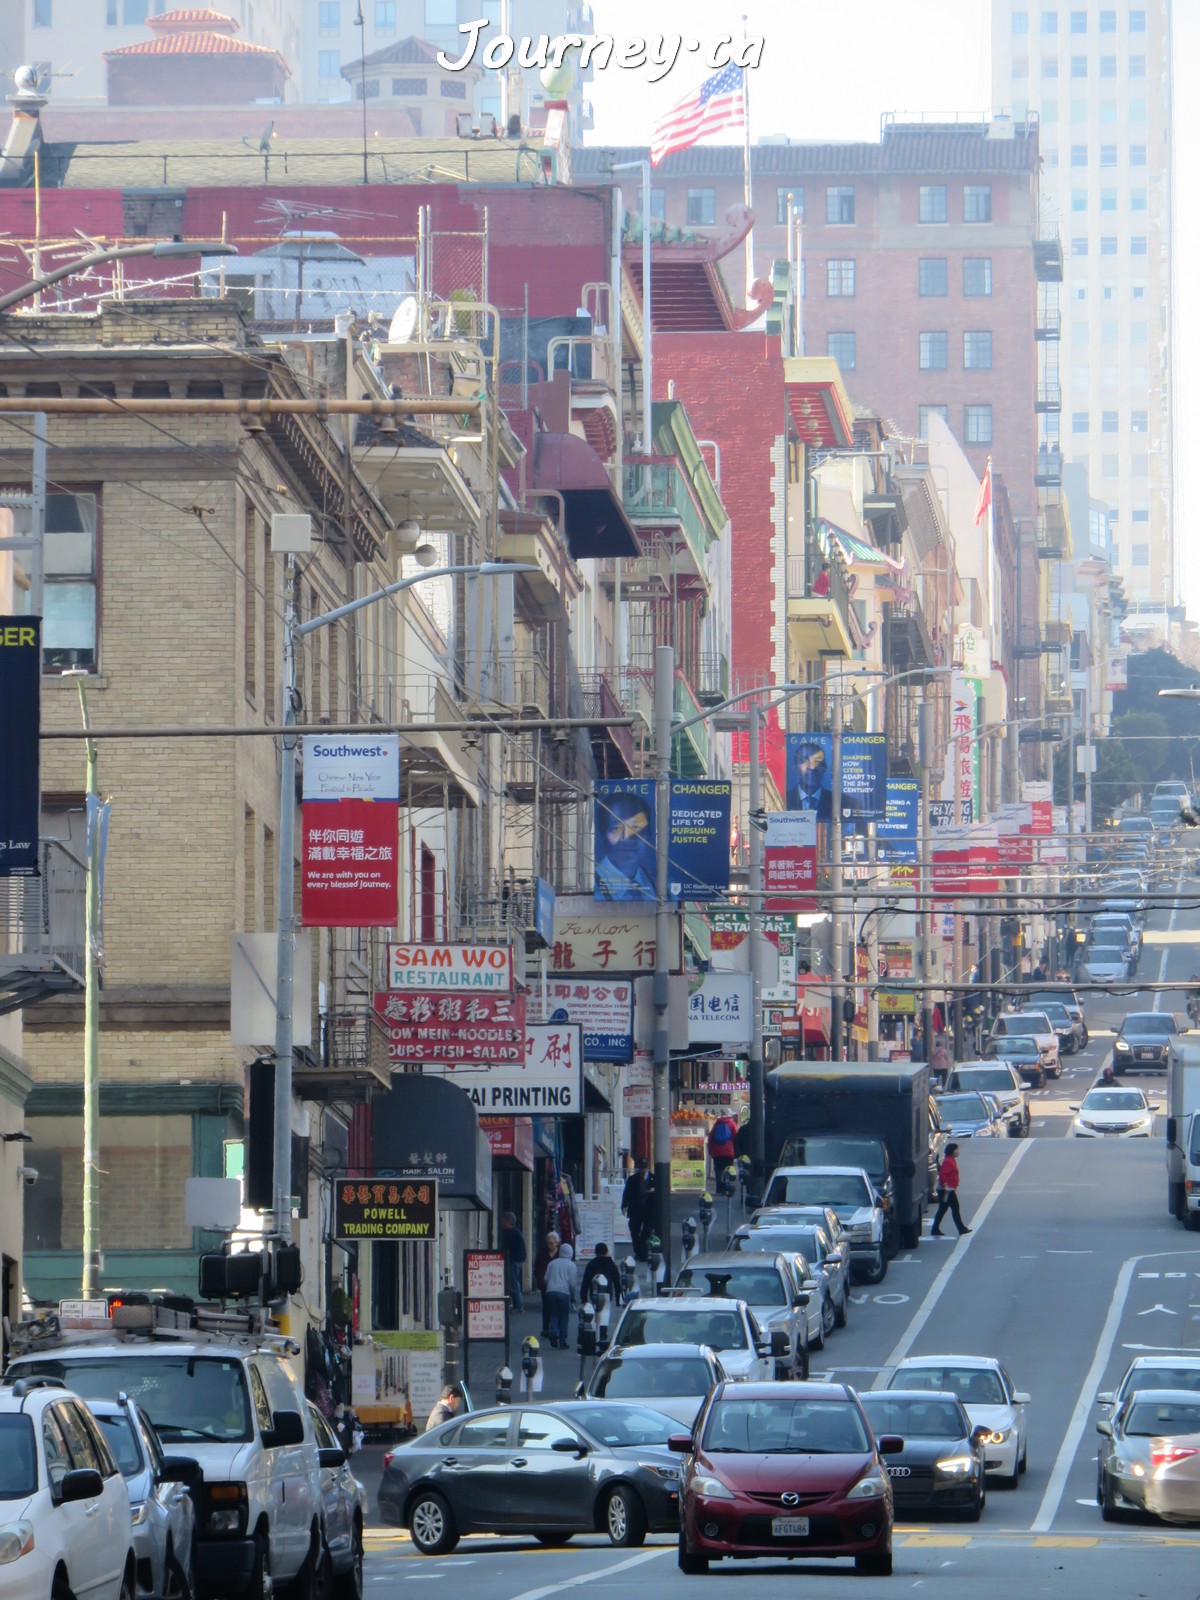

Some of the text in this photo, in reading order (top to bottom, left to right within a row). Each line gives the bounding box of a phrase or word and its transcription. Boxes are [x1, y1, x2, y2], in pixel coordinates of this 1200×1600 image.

[790, 736, 827, 744] GAME
[842, 736, 885, 744] CHANGER
[313, 744, 382, 758] Southwest
[348, 772, 364, 781] New
[365, 772, 382, 780] Year
[600, 784, 649, 795] GAME
[672, 784, 730, 795] CHANGER
[671, 810, 722, 818] DEDICATED
[308, 829, 364, 844] 伴你同遊
[10, 840, 31, 850] Law
[559, 922, 640, 936] Fashion
[394, 948, 506, 969] SAM WO
[551, 940, 656, 970] 龍子行
[394, 970, 505, 986] RESTAURANT
[492, 1086, 570, 1106] PRINTING
[364, 1208, 407, 1220] POWELL
[344, 1223, 430, 1234] TRADING COMPANY
[469, 1303, 480, 1312] NO
